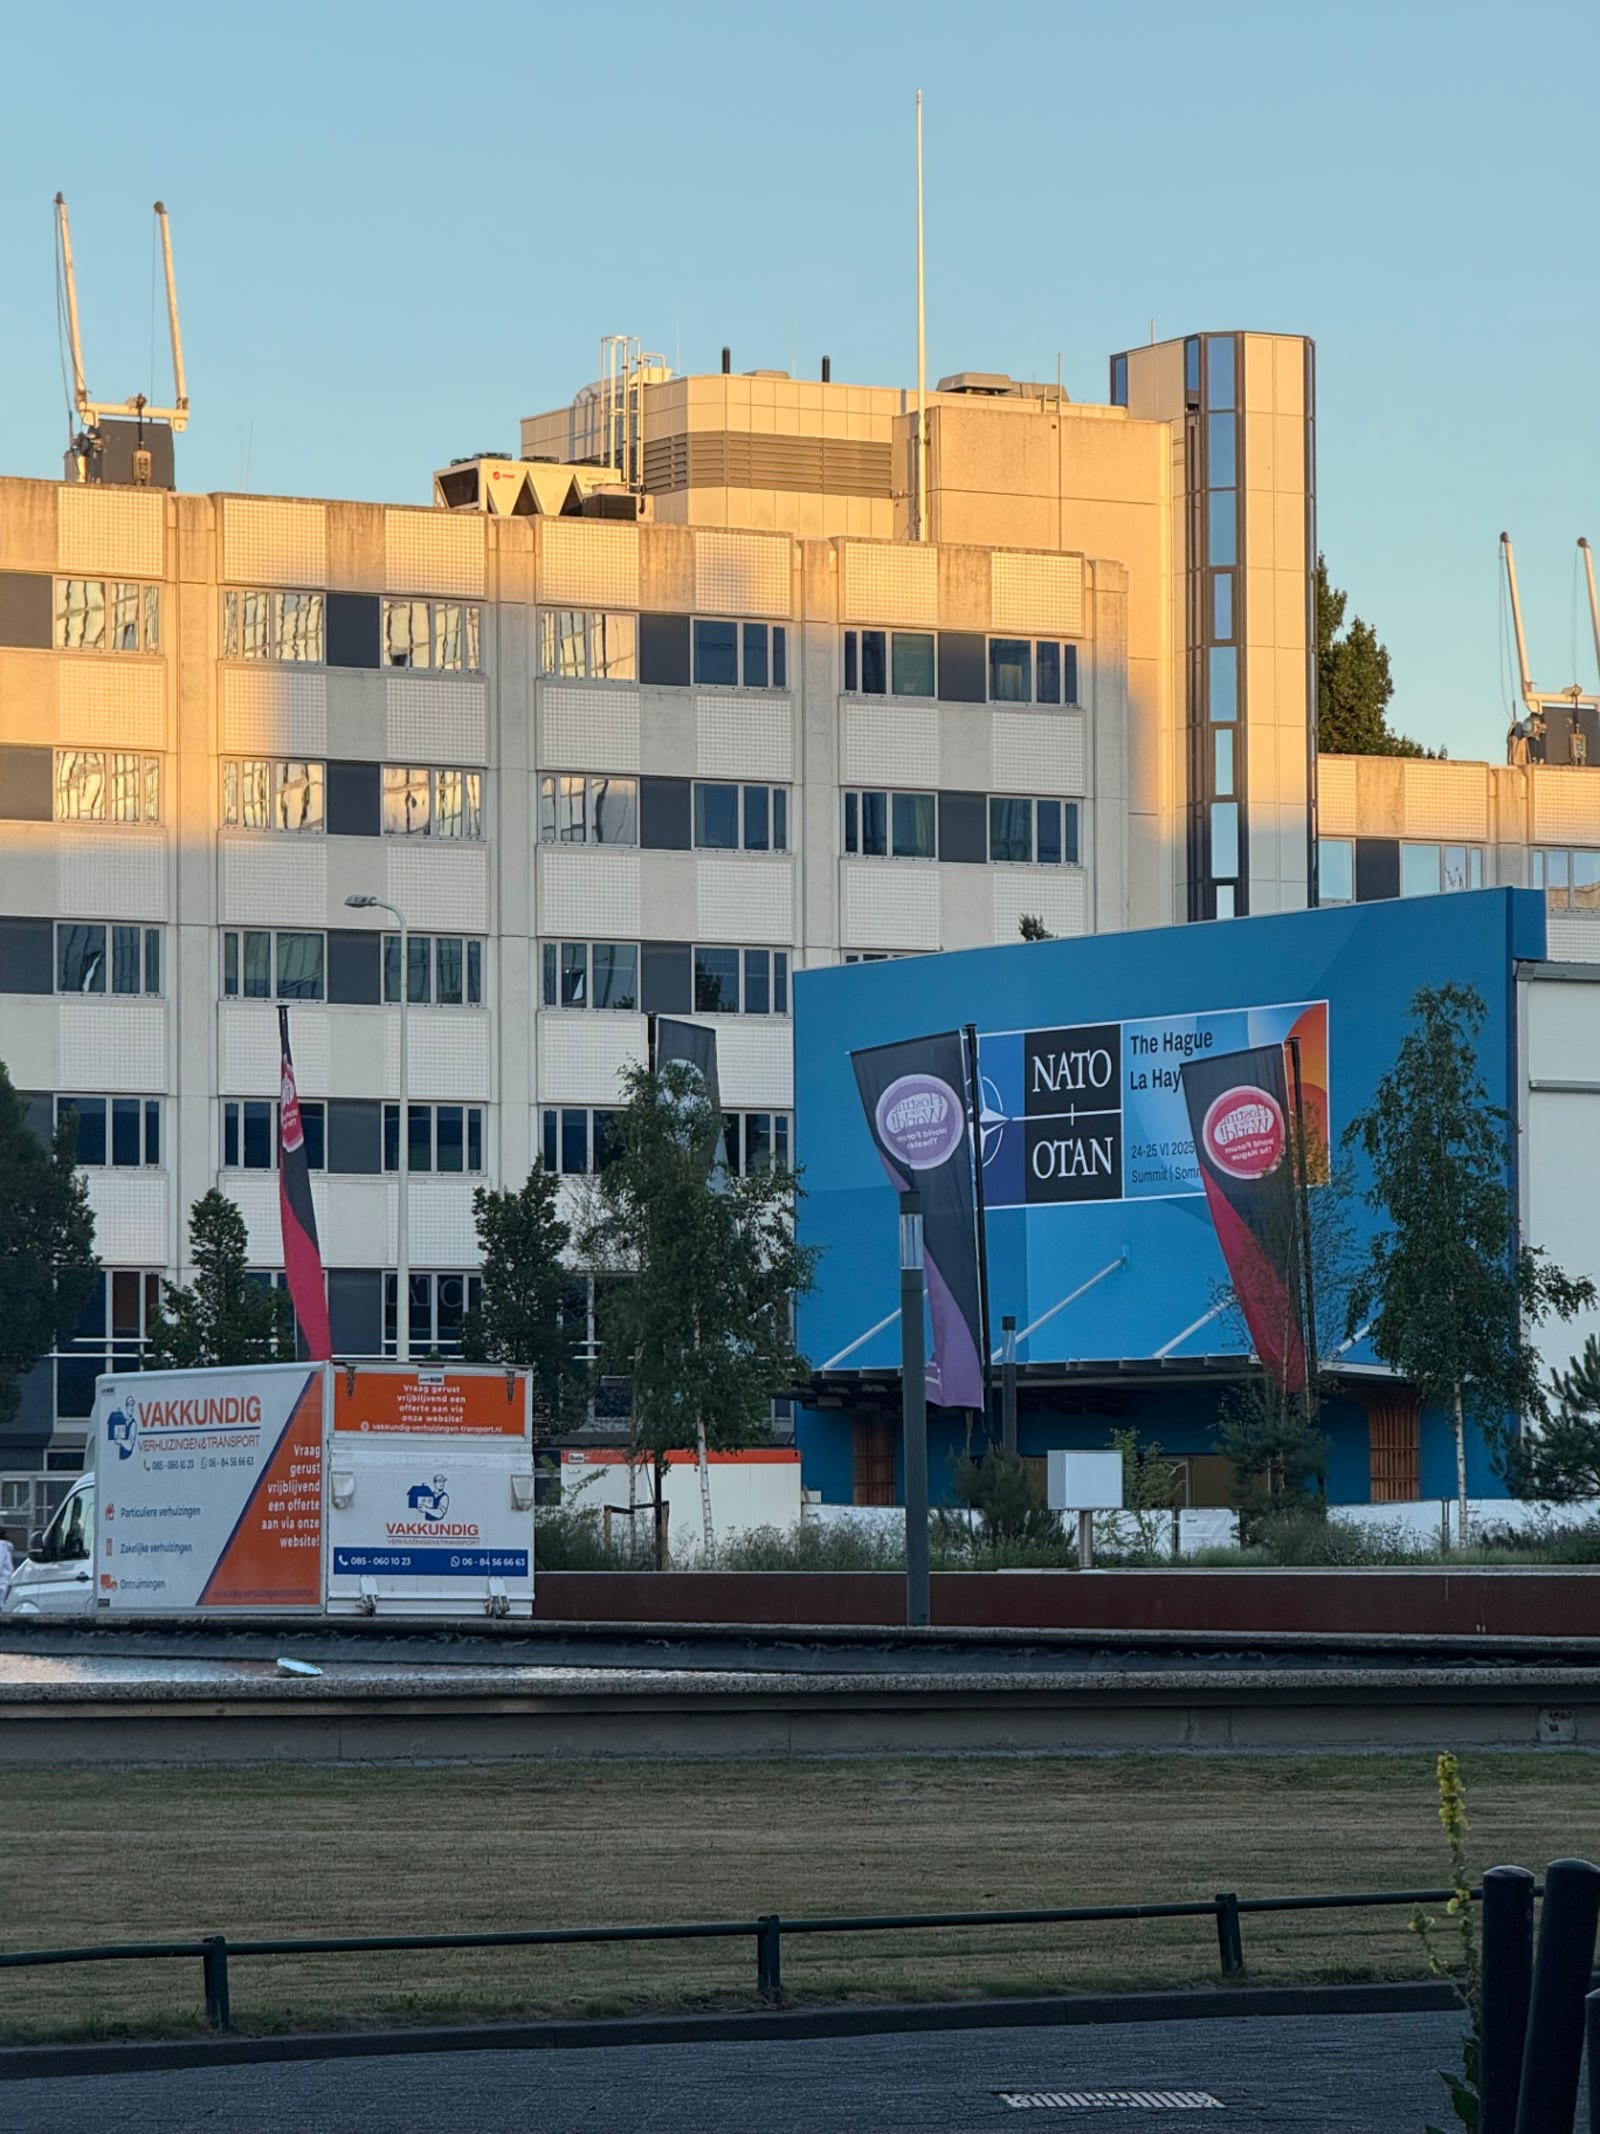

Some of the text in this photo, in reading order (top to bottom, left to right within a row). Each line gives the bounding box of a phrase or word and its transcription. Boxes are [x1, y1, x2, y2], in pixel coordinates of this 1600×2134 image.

[1131, 1031, 1213, 1056] The Hague
[1032, 1049, 1112, 1093] NATO
[1130, 1068, 1182, 1093] La Hay
[1131, 1140, 1195, 1159] 24-25 VI 2025
[1032, 1137, 1113, 1179] OTAN
[1132, 1166, 1168, 1183] Summit
[403, 1384, 460, 1395] Vraag gerust
[397, 1394, 466, 1404] vrijblijvend een
[138, 1395, 262, 1428] VAKKUNDIG
[399, 1404, 430, 1413] offerte
[402, 1414, 463, 1423] onze website!
[293, 1444, 321, 1458] Vraag
[290, 1464, 321, 1477] gerust
[267, 1481, 320, 1496] vrijblijvend
[268, 1499, 320, 1512] een offerte
[262, 1517, 320, 1530] aan via onze
[386, 1522, 479, 1536] VAKKUNDIG
[280, 1536, 320, 1548] website!
[350, 1556, 366, 1565] 085
[373, 1556, 390, 1565] 060
[391, 1556, 400, 1565] 10
[401, 1556, 411, 1566] 23
[462, 1557, 473, 1566] 06
[479, 1557, 490, 1566] 84
[492, 1557, 502, 1566] 56
[503, 1557, 514, 1566] 66
[515, 1558, 526, 1567] 63
